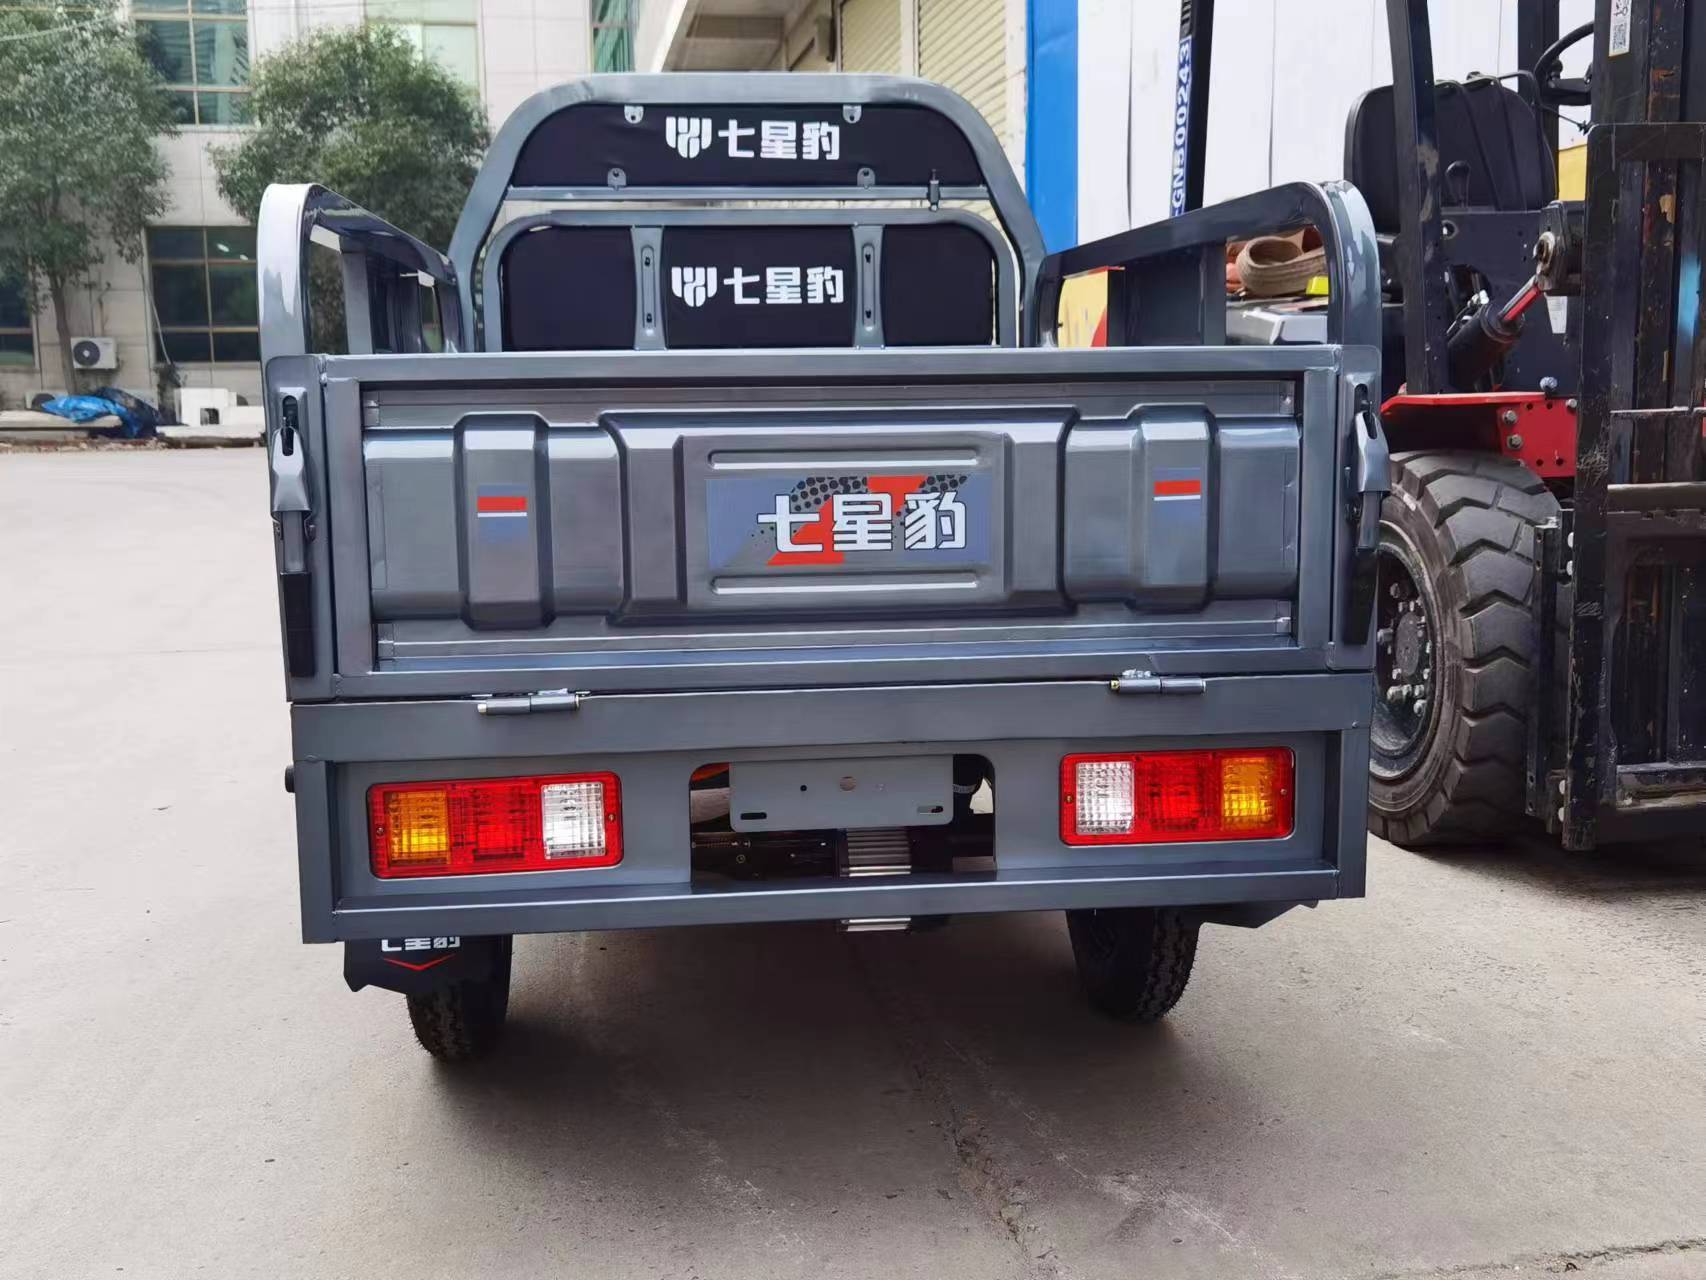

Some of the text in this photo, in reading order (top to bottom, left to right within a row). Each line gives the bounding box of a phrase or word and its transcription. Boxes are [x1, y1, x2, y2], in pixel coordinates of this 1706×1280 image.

[718, 119, 840, 160] 七星豹
[723, 266, 844, 304] 七星豹
[756, 492, 967, 553] 七星豹
